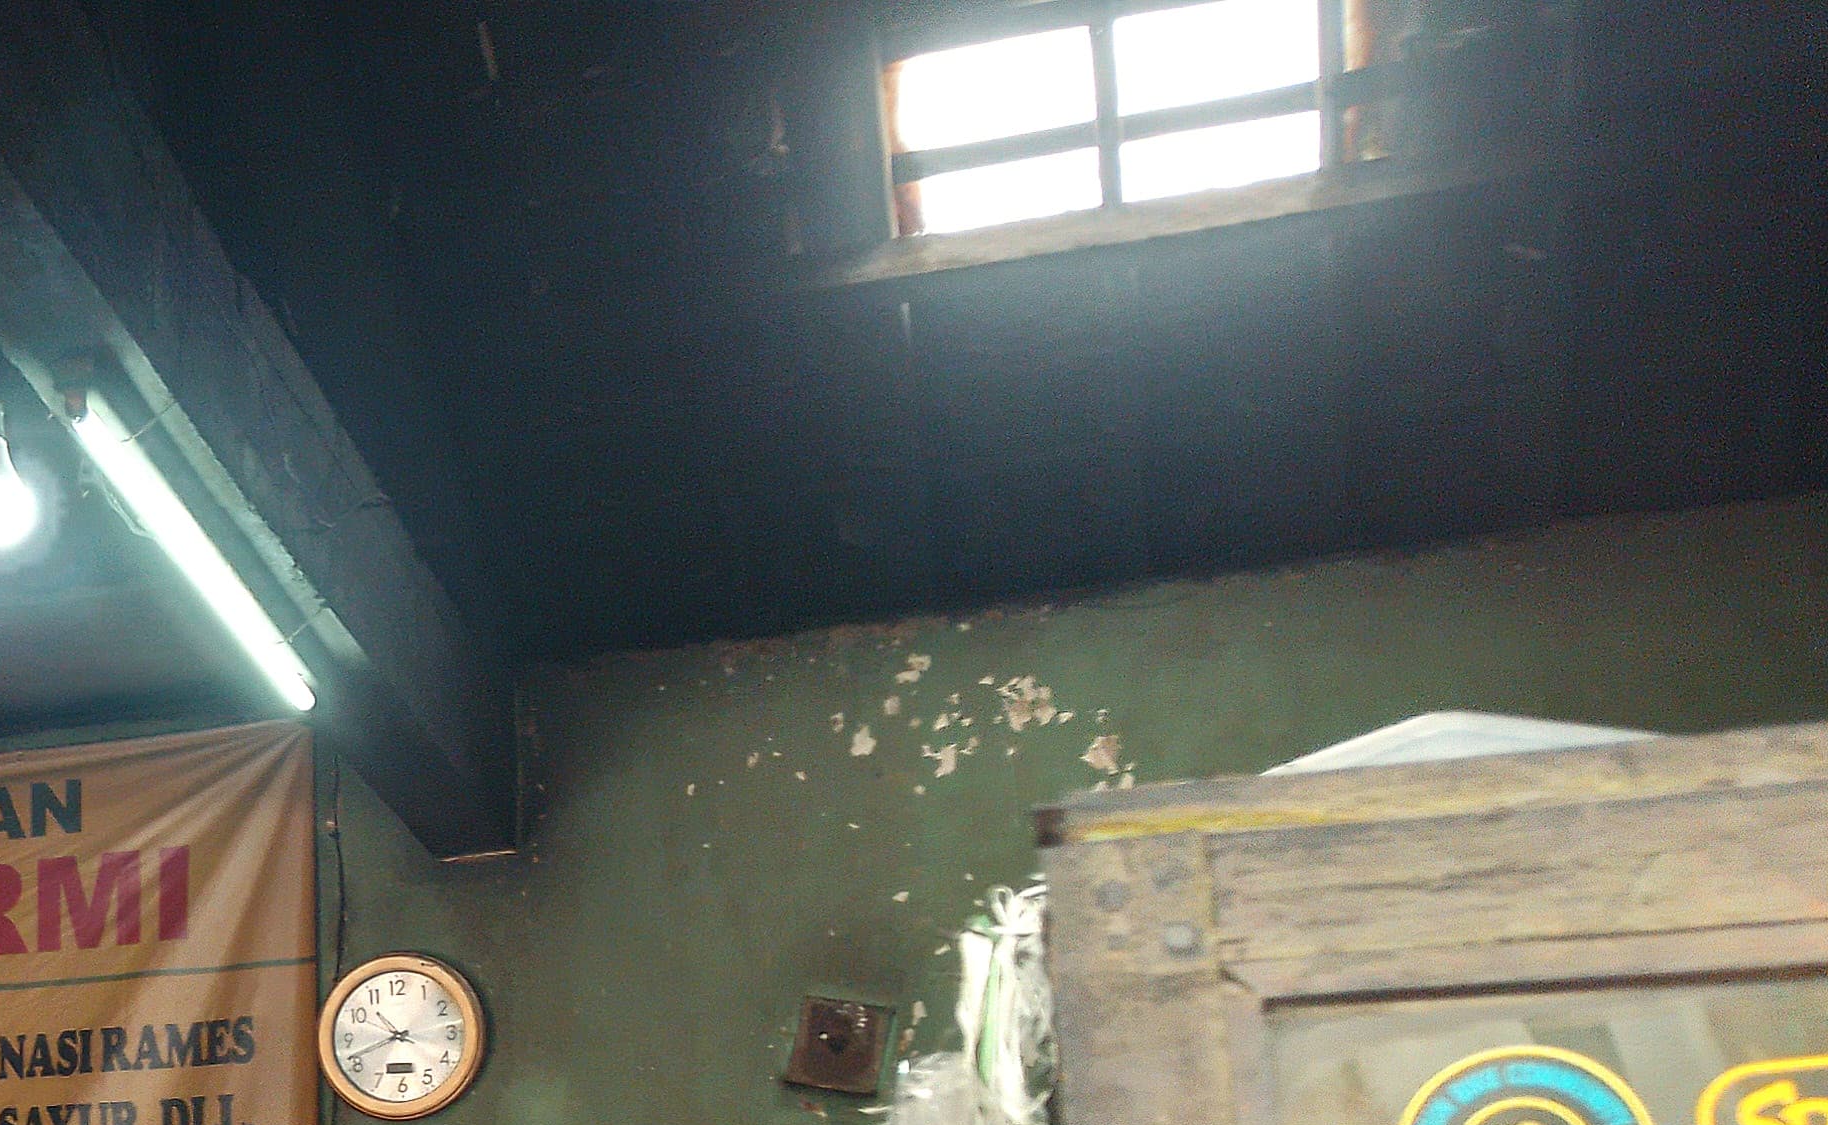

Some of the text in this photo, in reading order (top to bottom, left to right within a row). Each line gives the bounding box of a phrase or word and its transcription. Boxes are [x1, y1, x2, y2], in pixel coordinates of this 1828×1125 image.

[389, 980, 405, 996] 12
[421, 984, 426, 1000] 1
[369, 989, 379, 1005] 11
[351, 1007, 366, 1024] 10
[437, 1000, 447, 1017] 2
[344, 1033, 353, 1048] 9
[446, 1025, 457, 1040] 3
[352, 1056, 363, 1072] 8
[440, 1050, 450, 1064] 4
[374, 1073, 384, 1088] 7
[398, 1077, 408, 1093] 6
[422, 1069, 432, 1085] 5
